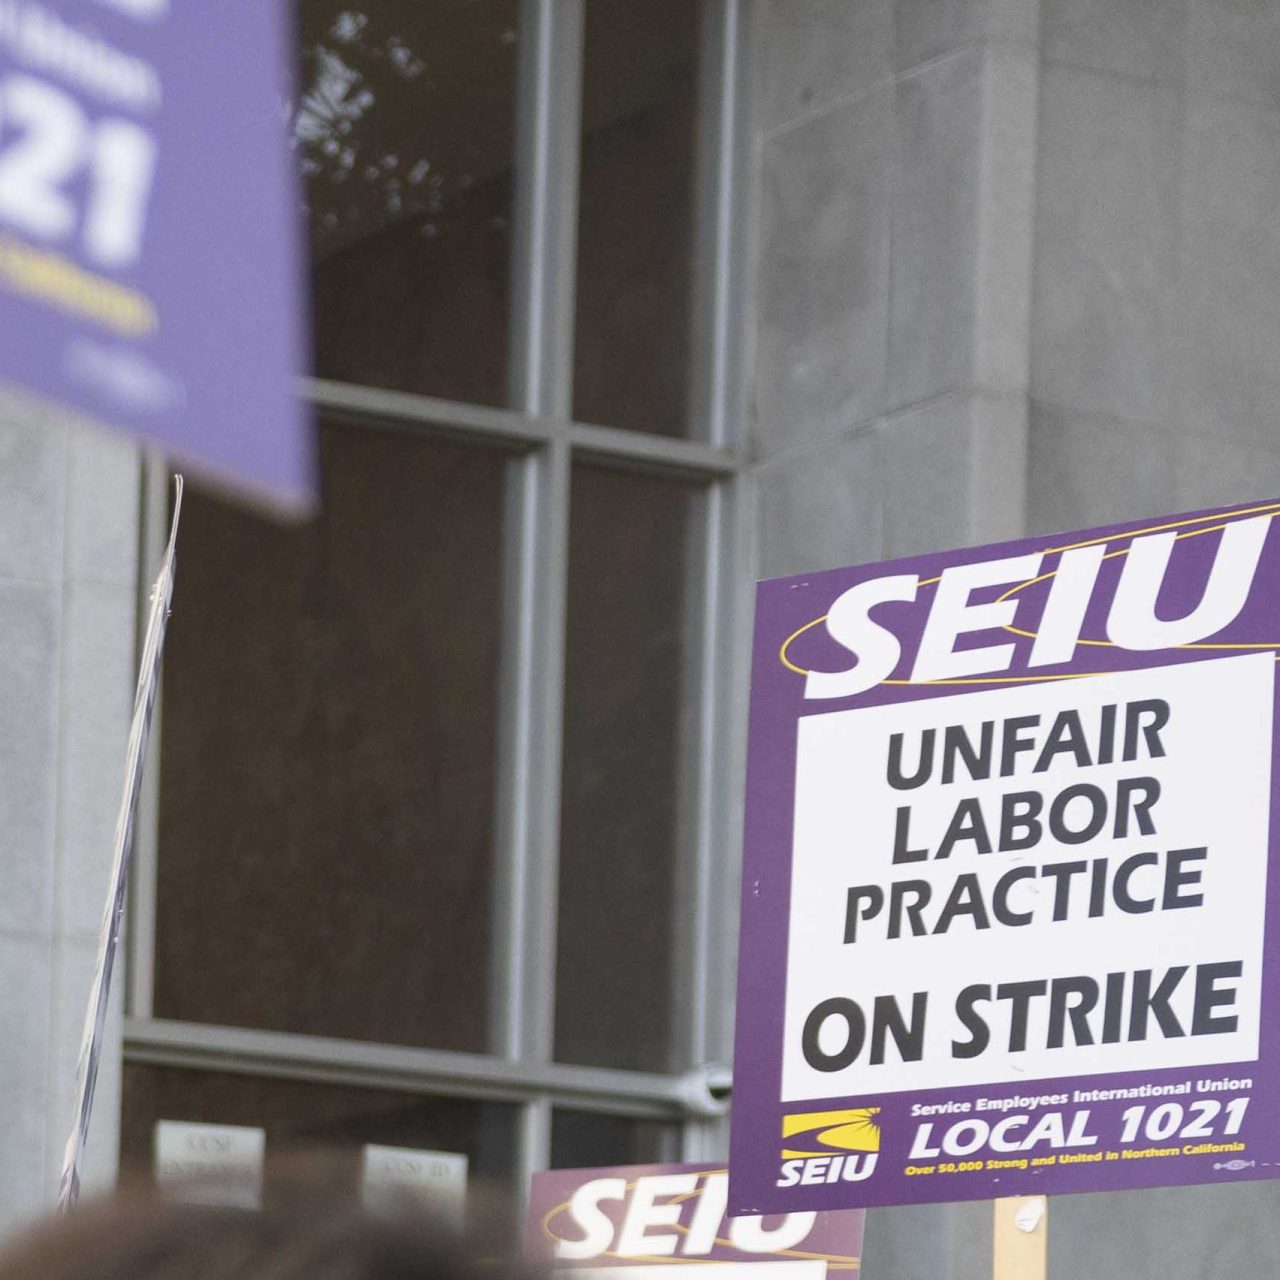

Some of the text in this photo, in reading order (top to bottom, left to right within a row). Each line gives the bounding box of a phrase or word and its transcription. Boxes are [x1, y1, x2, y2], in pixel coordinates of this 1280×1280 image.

[804, 515, 1272, 700] SEIU
[886, 698, 1170, 791] UNFAIR
[891, 776, 1162, 865] LABOR
[843, 847, 1208, 945] PRACTICE
[801, 960, 1244, 1074] ON STRIKE
[908, 1097, 1250, 1160] LOCAL 1021
[910, 1077, 1253, 1117] Service Employees International Union
[776, 1153, 879, 1187] SEIU
[904, 1141, 1245, 1176] Over 50,000 Strong and United in Northern California
